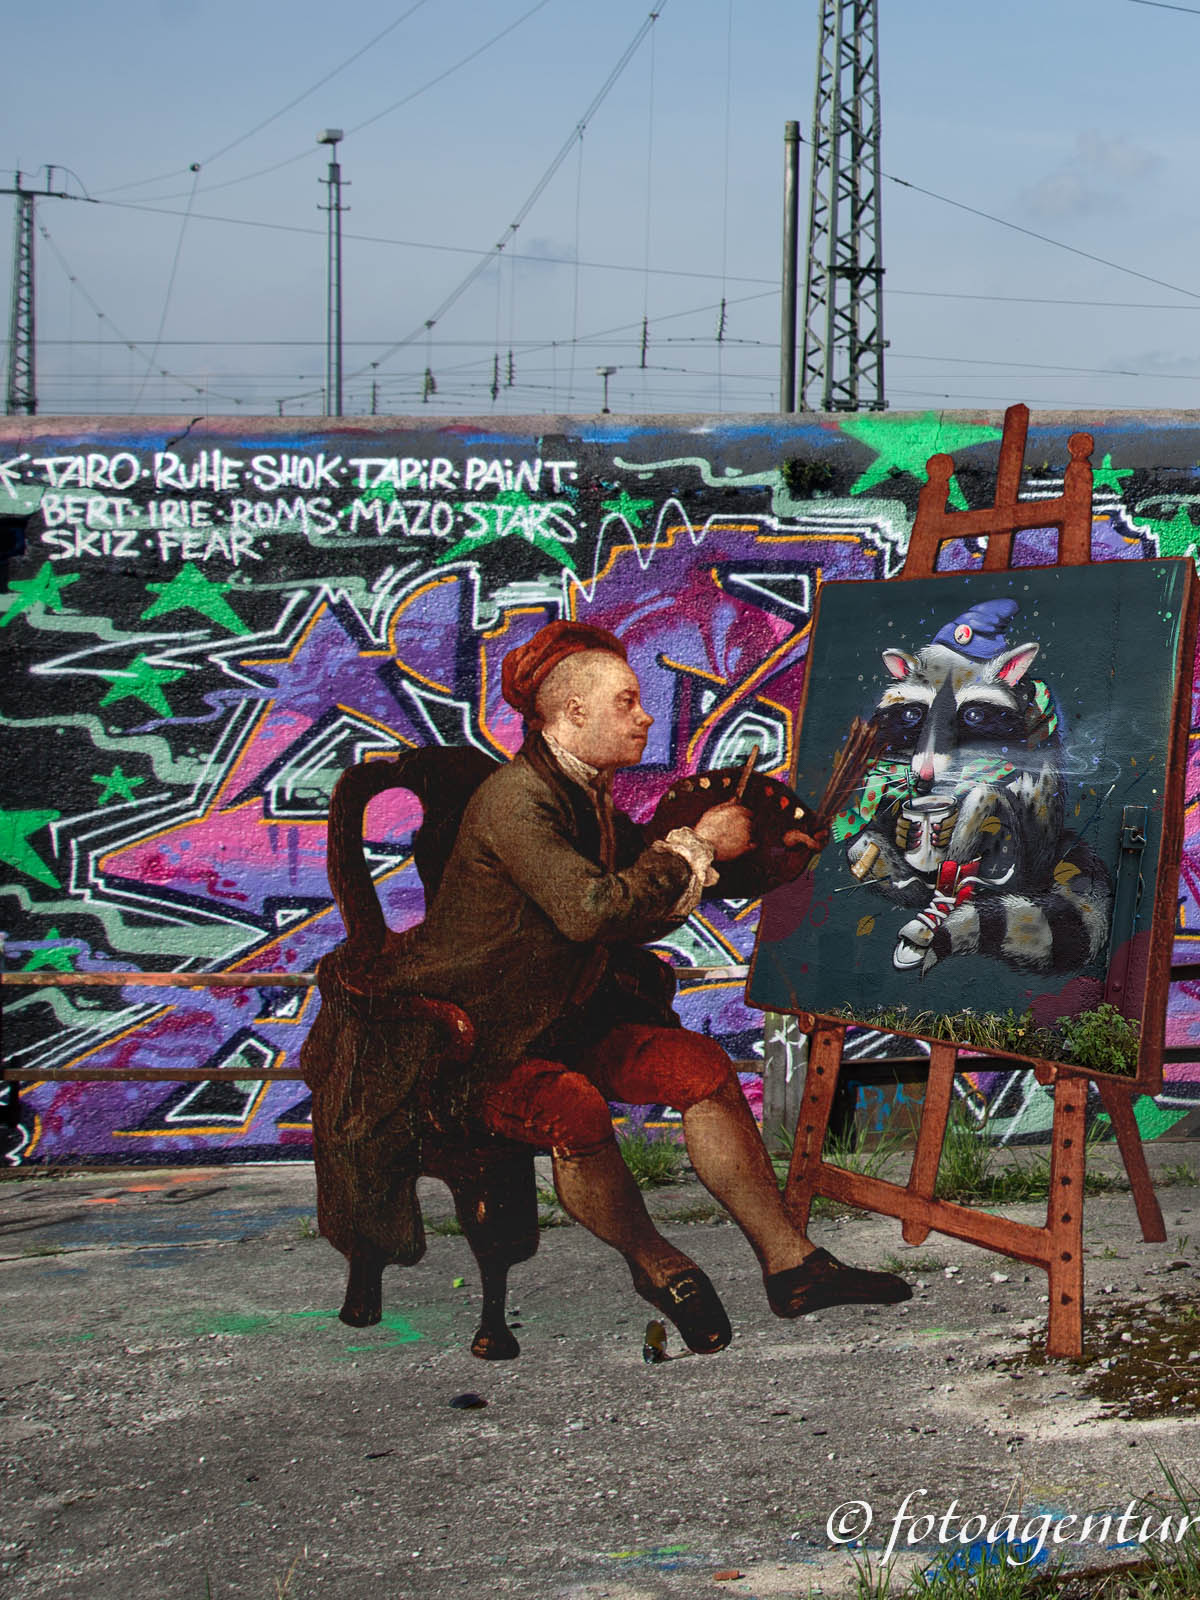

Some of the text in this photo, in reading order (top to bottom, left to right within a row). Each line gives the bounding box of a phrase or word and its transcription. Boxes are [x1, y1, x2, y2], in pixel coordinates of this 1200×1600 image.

[33, 452, 140, 490] TARO
[251, 453, 342, 491] SHOK
[40, 495, 578, 543] BERT IRIE ROMS MAZO STARS
[40, 529, 263, 566] SKIZ FEAR
